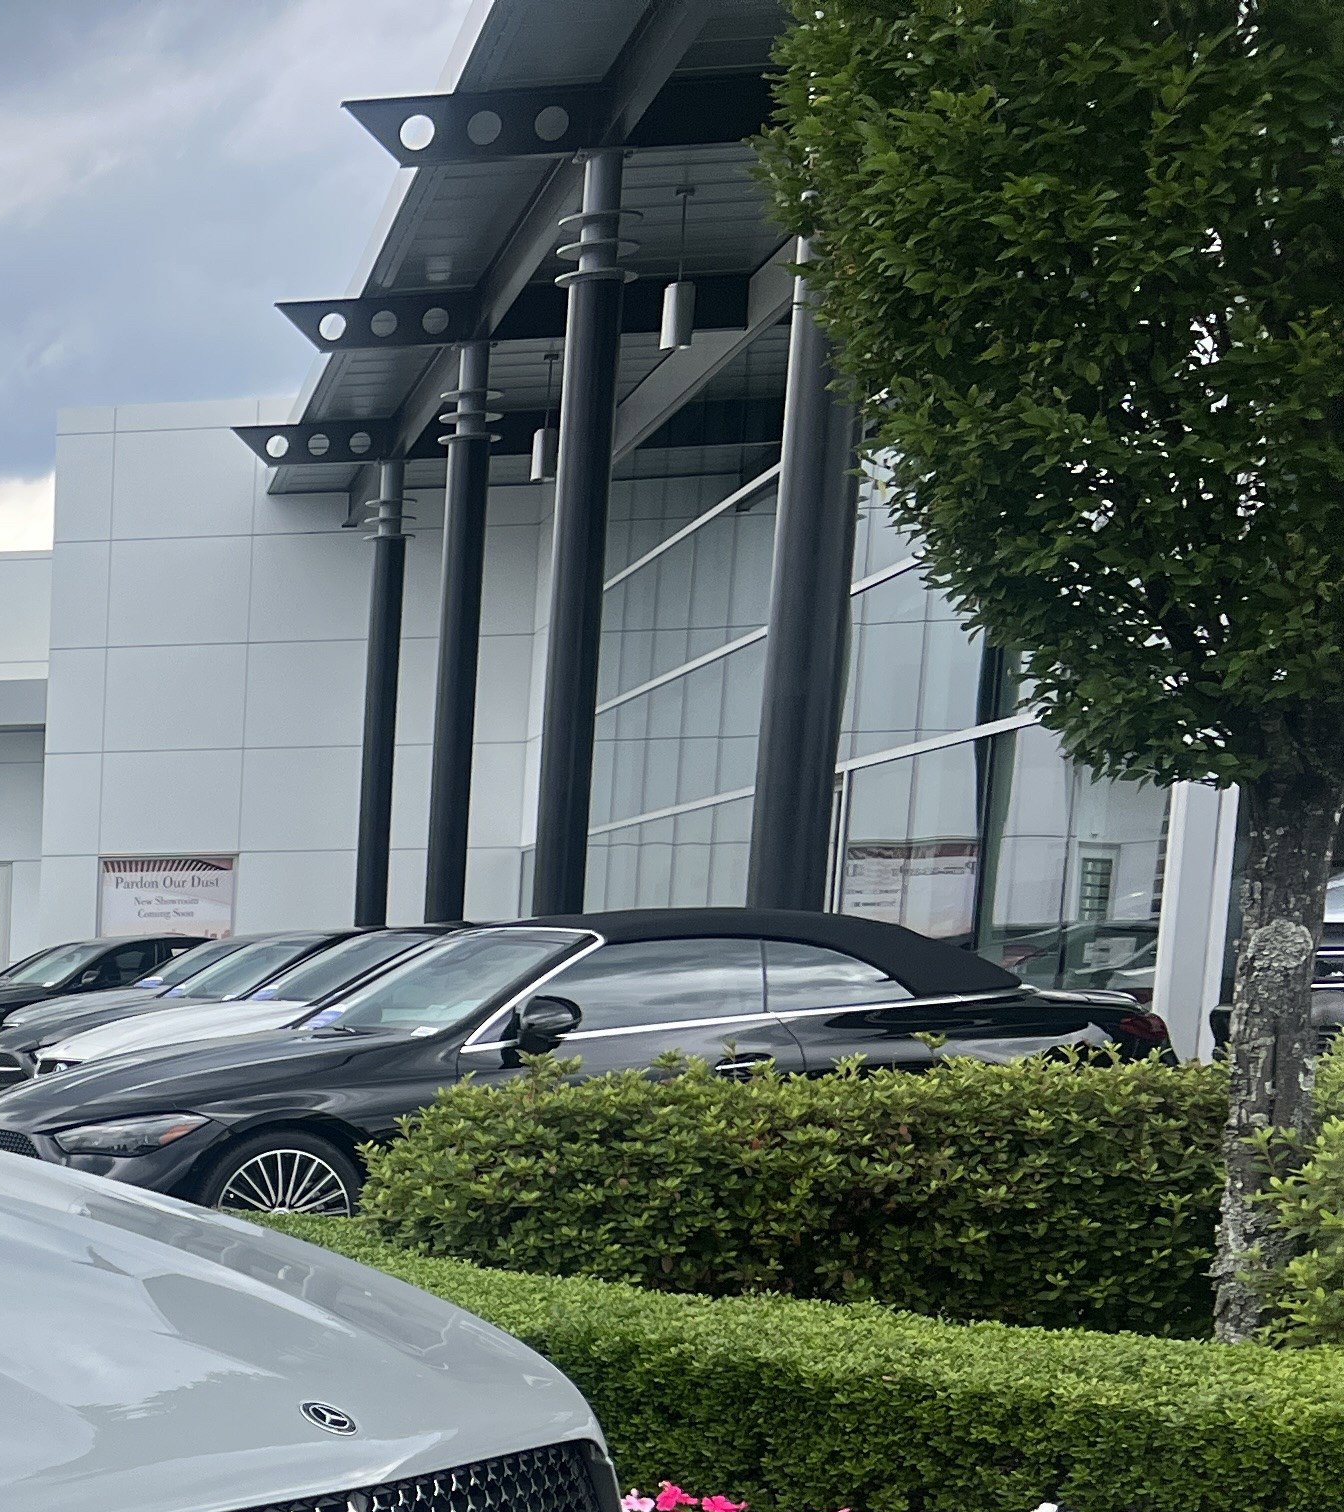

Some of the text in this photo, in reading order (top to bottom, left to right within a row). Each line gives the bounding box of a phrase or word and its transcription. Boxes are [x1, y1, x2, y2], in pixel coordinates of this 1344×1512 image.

[115, 874, 220, 889] Pardon Our Dust
[134, 896, 199, 905] New Showroom
[137, 908, 194, 920] Coming Soon
